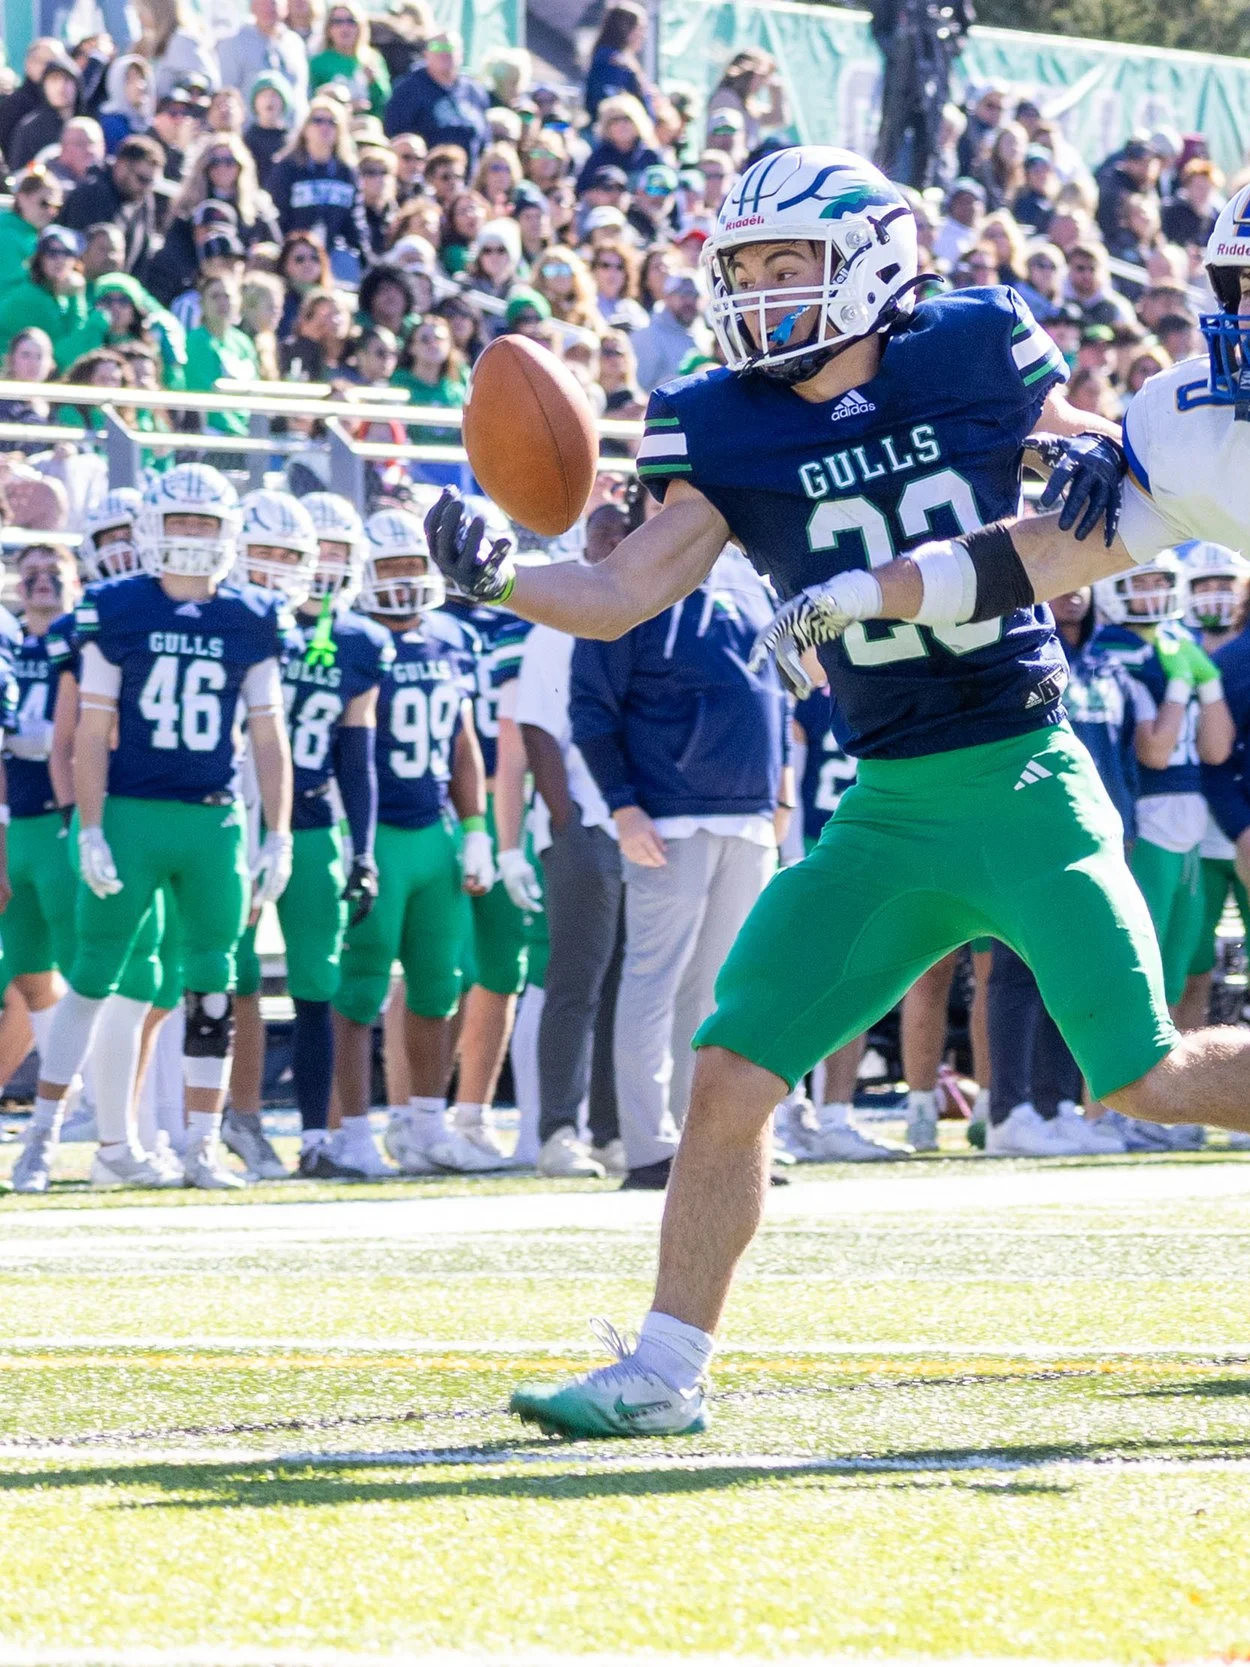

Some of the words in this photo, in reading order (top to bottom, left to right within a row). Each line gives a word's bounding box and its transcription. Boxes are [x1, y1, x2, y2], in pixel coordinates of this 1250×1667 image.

[831, 401, 877, 421] adidas
[797, 423, 942, 500] GULLS
[150, 631, 225, 658] GULLS
[392, 658, 451, 684] GULLS
[139, 655, 227, 751] 46
[388, 684, 461, 779] 99
